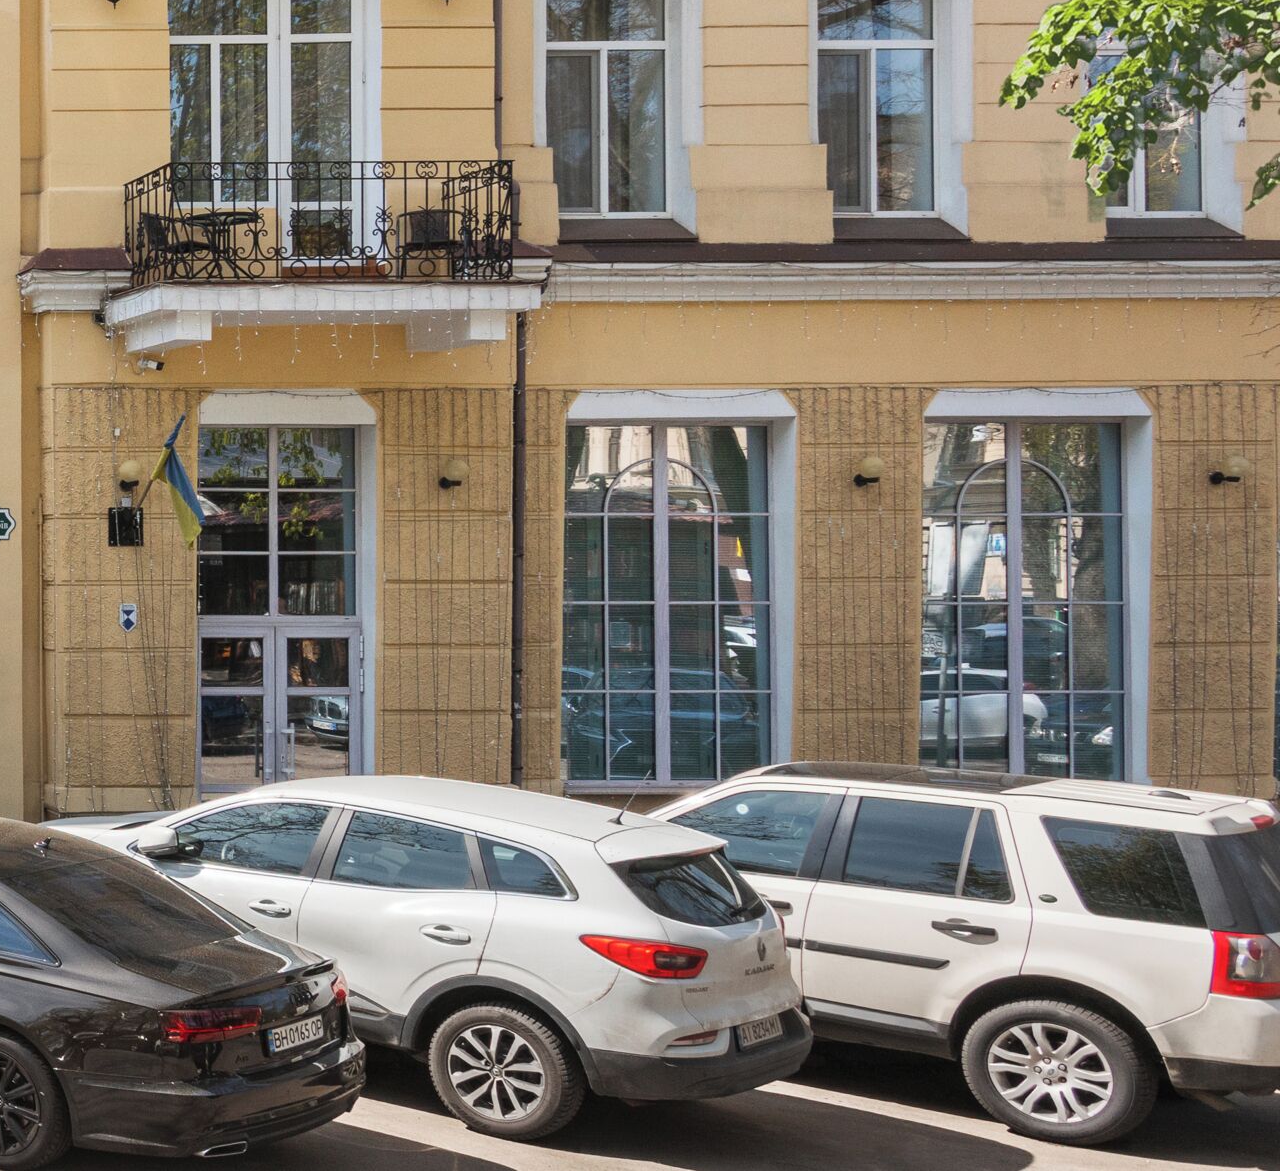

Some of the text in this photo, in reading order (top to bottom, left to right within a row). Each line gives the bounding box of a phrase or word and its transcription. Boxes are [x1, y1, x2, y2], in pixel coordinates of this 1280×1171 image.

[273, 1018, 322, 1049] BH 0165 OP
[752, 1019, 771, 1039] 8234
